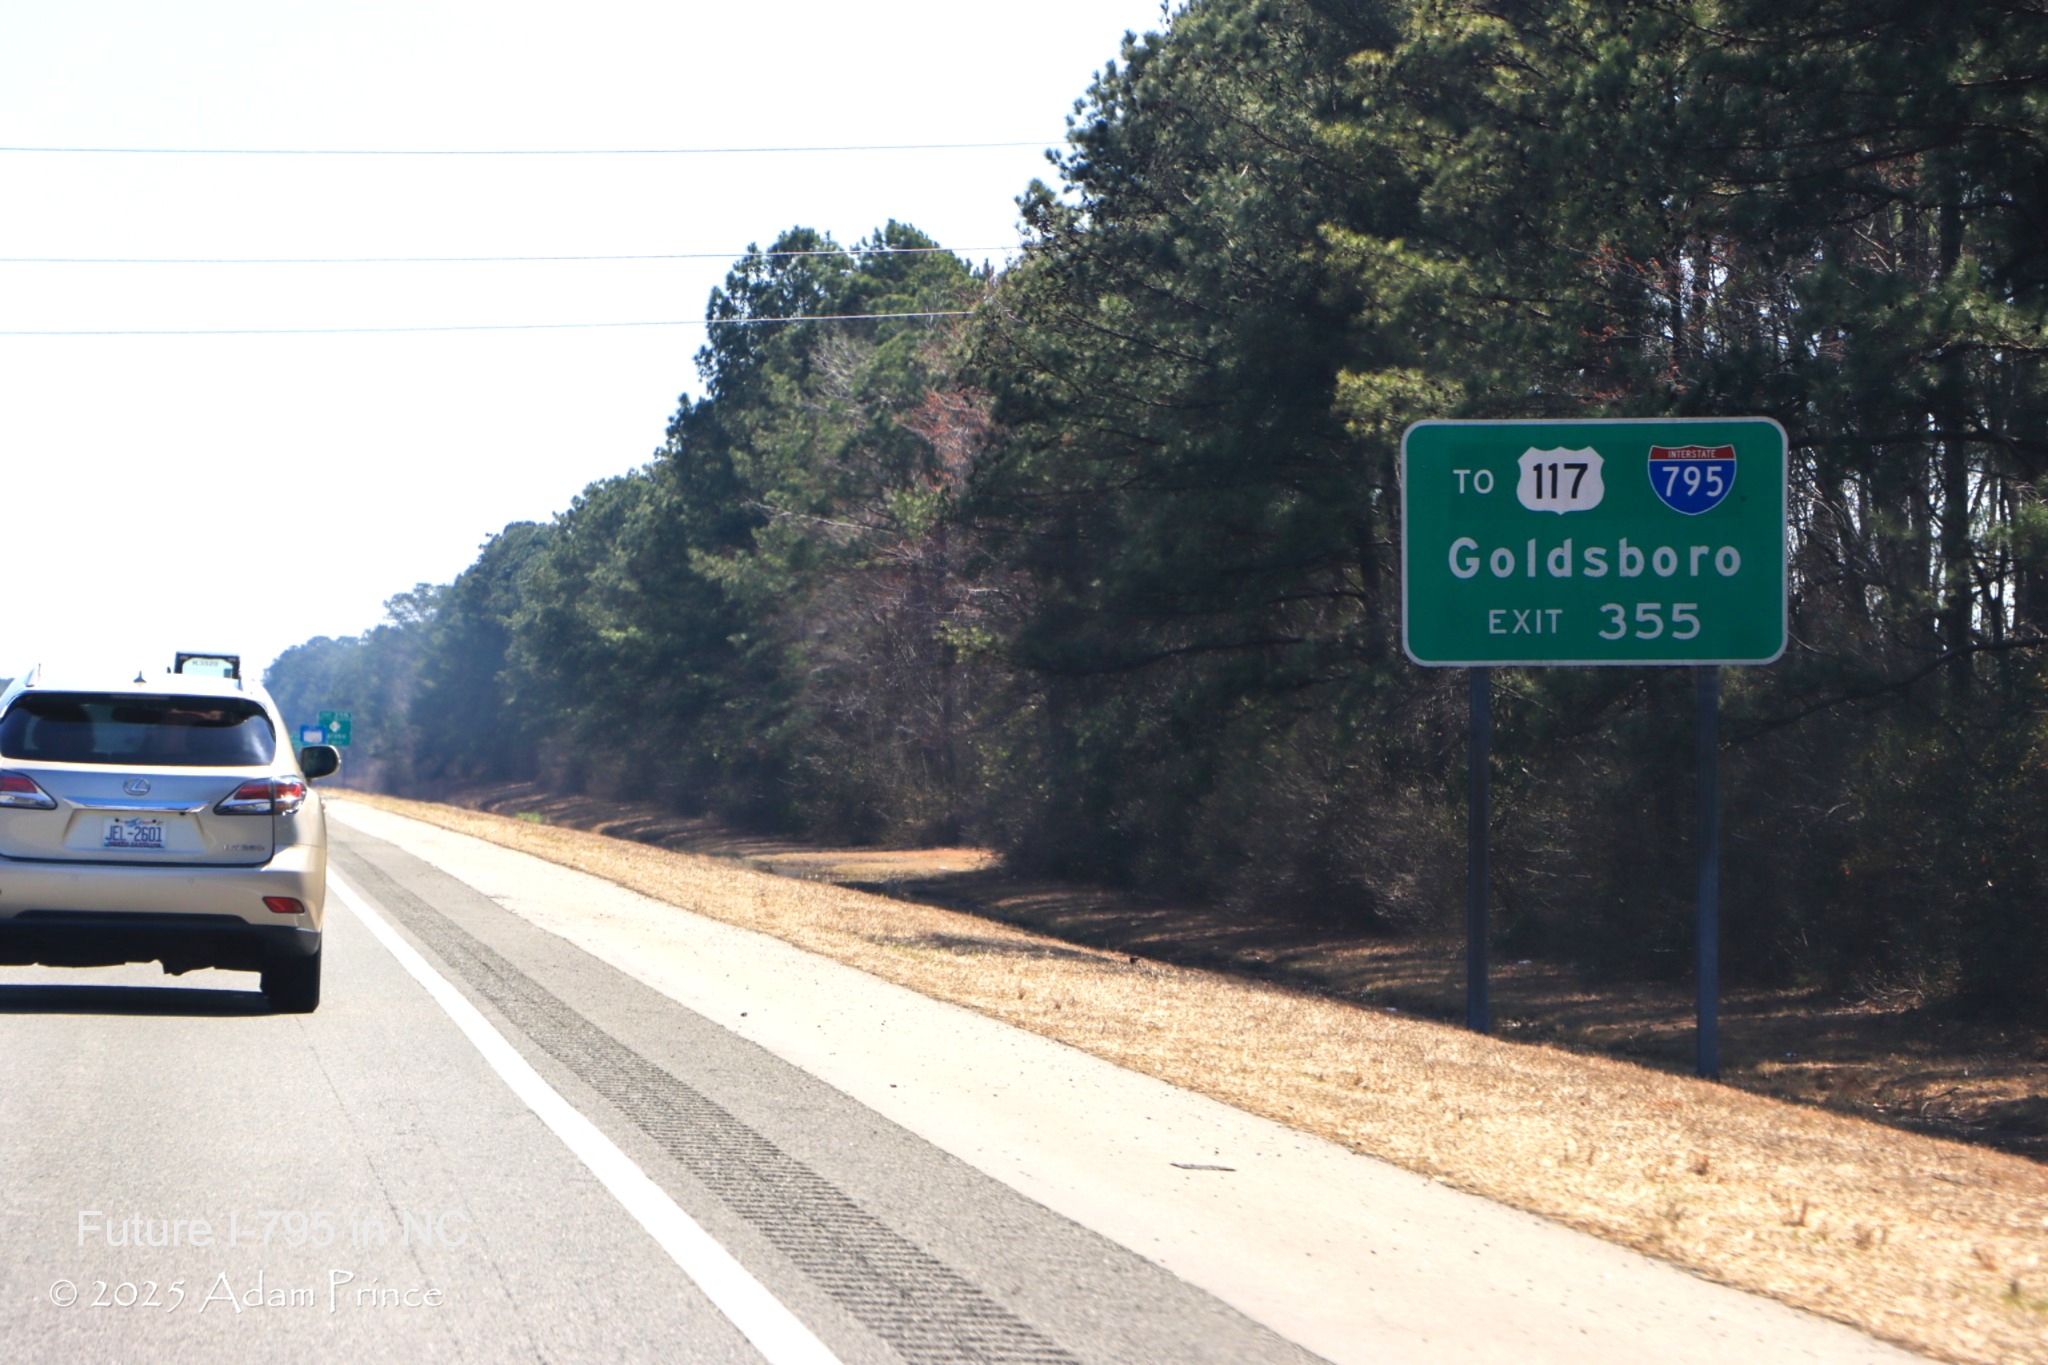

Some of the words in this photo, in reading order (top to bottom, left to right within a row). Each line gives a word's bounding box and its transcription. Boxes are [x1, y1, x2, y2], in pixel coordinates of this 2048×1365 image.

[1668, 449, 1717, 459] INTERSTATE
[1453, 469, 1494, 494] TO
[1532, 463, 1589, 499] 117
[1662, 466, 1724, 497] 795
[1448, 537, 1741, 579] Goldsboro
[1489, 609, 1563, 634] EXIT
[1599, 603, 1700, 639] 355
